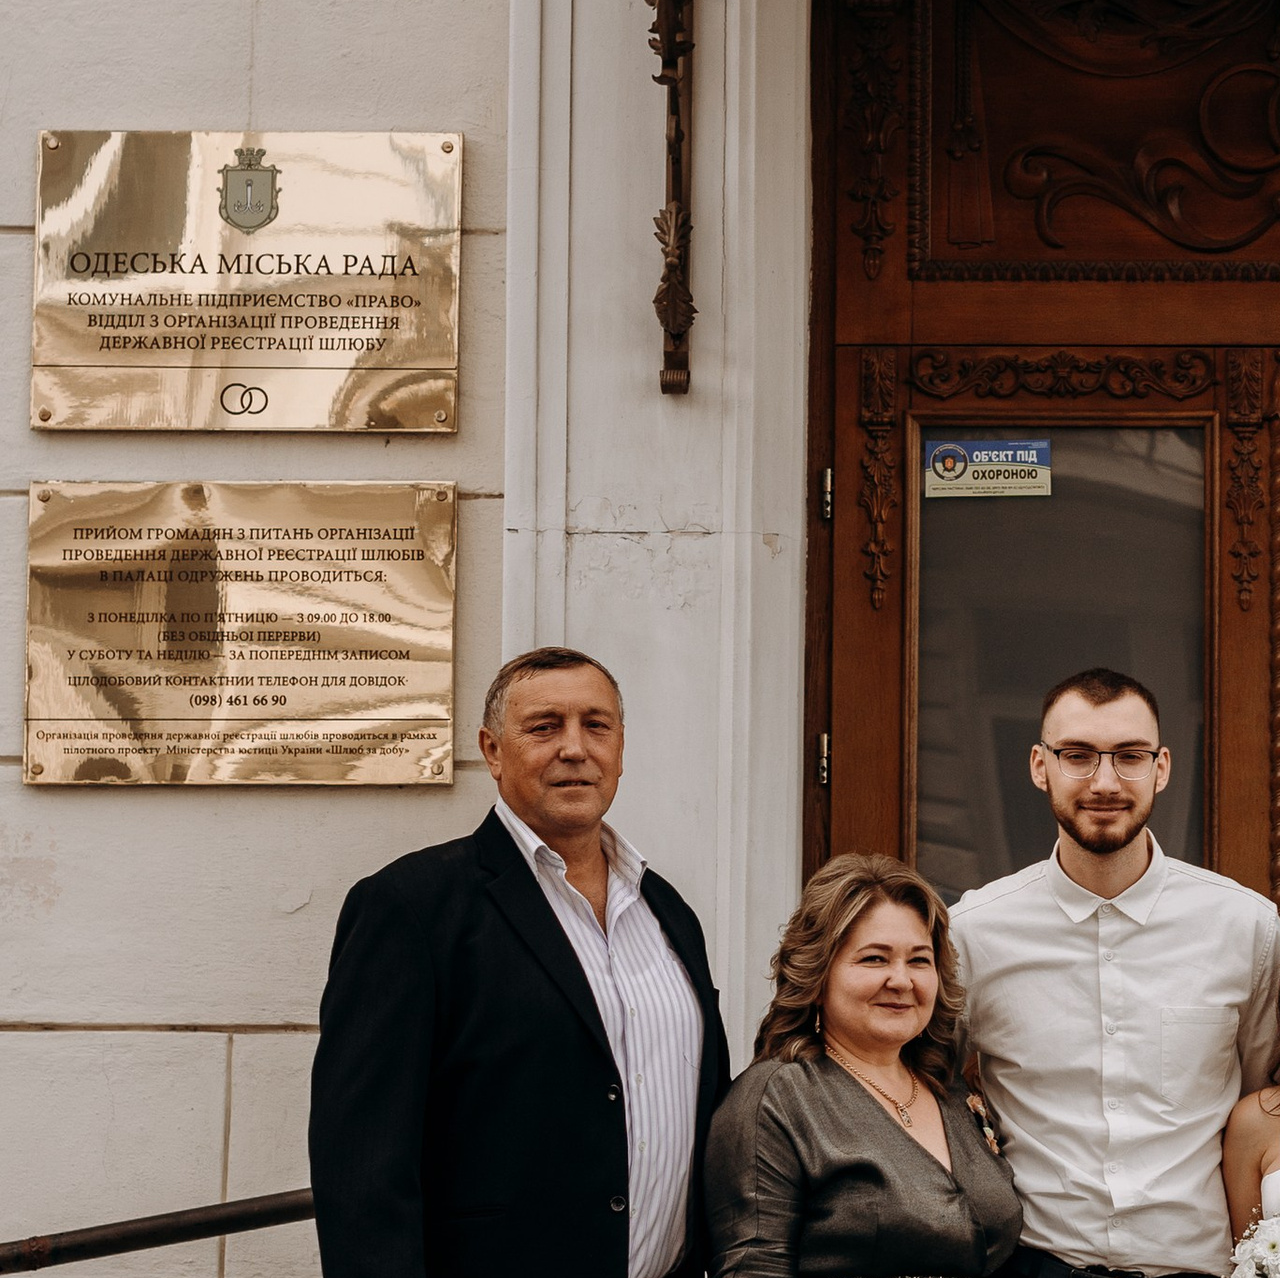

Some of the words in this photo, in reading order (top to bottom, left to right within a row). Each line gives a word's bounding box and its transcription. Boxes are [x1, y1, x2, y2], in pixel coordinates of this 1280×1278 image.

[70, 252, 208, 277] ОДЕСЬКА
[217, 253, 334, 276] МІСЬКА
[342, 254, 420, 280] РАДА
[67, 292, 193, 307] КОМУНАЛЬНЕ
[198, 293, 342, 308] ПІДПРИЄМСТВО
[346, 294, 421, 309] «ПРАВО»
[87, 313, 145, 330] ВІДДІЛ
[149, 314, 159, 328] З
[164, 313, 277, 331] ОРГАНІЗАЦІЇ
[281, 315, 400, 331] ПРОВЕДЕННЯ
[99, 334, 206, 351] ДЕРЖАВНОЇ
[211, 335, 314, 352] РЕЄСТРАЦІЇ
[319, 337, 387, 351] ШЛЮБУ
[972, 450, 1014, 463] ОБ'ЄКТ
[1016, 450, 1037, 463] ПІД
[972, 468, 1038, 480] ОХОРОНОЮ
[73, 526, 142, 540] ПРИЙОМ
[147, 528, 233, 541] ГРОМАДЯН
[237, 528, 245, 540] З
[250, 528, 314, 540] ПИТАНЬ
[317, 526, 416, 542] ОРГАНІЗАЦІЇ
[62, 549, 166, 563] ПРОВЕДЕННЯ
[170, 547, 263, 563] ДЕРЖАВНОЇ
[267, 547, 358, 563] РЕЄСТРАЦІЇ
[361, 549, 425, 561] ШЛЮБІВ
[100, 571, 109, 582] В
[113, 571, 174, 583] ПАЛАЦІ
[177, 571, 264, 583] ОДРУЖЕНЬ
[268, 570, 388, 583] ПРОВОДИТЬСЯ:
[87, 613, 95, 623] З
[98, 613, 177, 624] ПОНЕДІЛКА
[181, 613, 200, 623] ПО
[306, 613, 337, 623] 09.00
[339, 613, 359, 624] ДО
[362, 613, 392, 623] 18.00
[157, 631, 185, 643] (БЕЗ
[257, 631, 321, 643] ПЕРЕРВИ)
[67, 650, 76, 661] У
[79, 650, 133, 661] СУБОТУ
[136, 650, 153, 660] ТА
[157, 650, 211, 662] НЕДІЛЮ
[229, 650, 246, 660] ЗА
[250, 650, 339, 662] ПОПЕРЕДНІМ
[342, 650, 410, 660] ЗАПИСОМ
[68, 674, 161, 688] ЦІЛОДОБОВИЙ
[257, 676, 318, 687] ТЕЛЕФОН
[321, 676, 346, 688] ДЛЯ
[189, 694, 222, 707] (098)
[226, 695, 248, 706] 461
[252, 695, 268, 706] 66
[271, 695, 287, 706] 90
[36, 730, 99, 742] Організація
[102, 732, 163, 742] проведення
[166, 730, 221, 742] державної
[223, 731, 277, 742] реєстрації
[279, 730, 319, 740] шлюбів
[322, 732, 389, 742] проводиться
[392, 732, 397, 740] в
[400, 732, 437, 742] рамках
[63, 745, 115, 755] пілотного
[166, 746, 236, 756] Міністерства
[281, 746, 323, 756] України
[326, 745, 364, 755] «Шлюб
[379, 746, 410, 756] добу»
